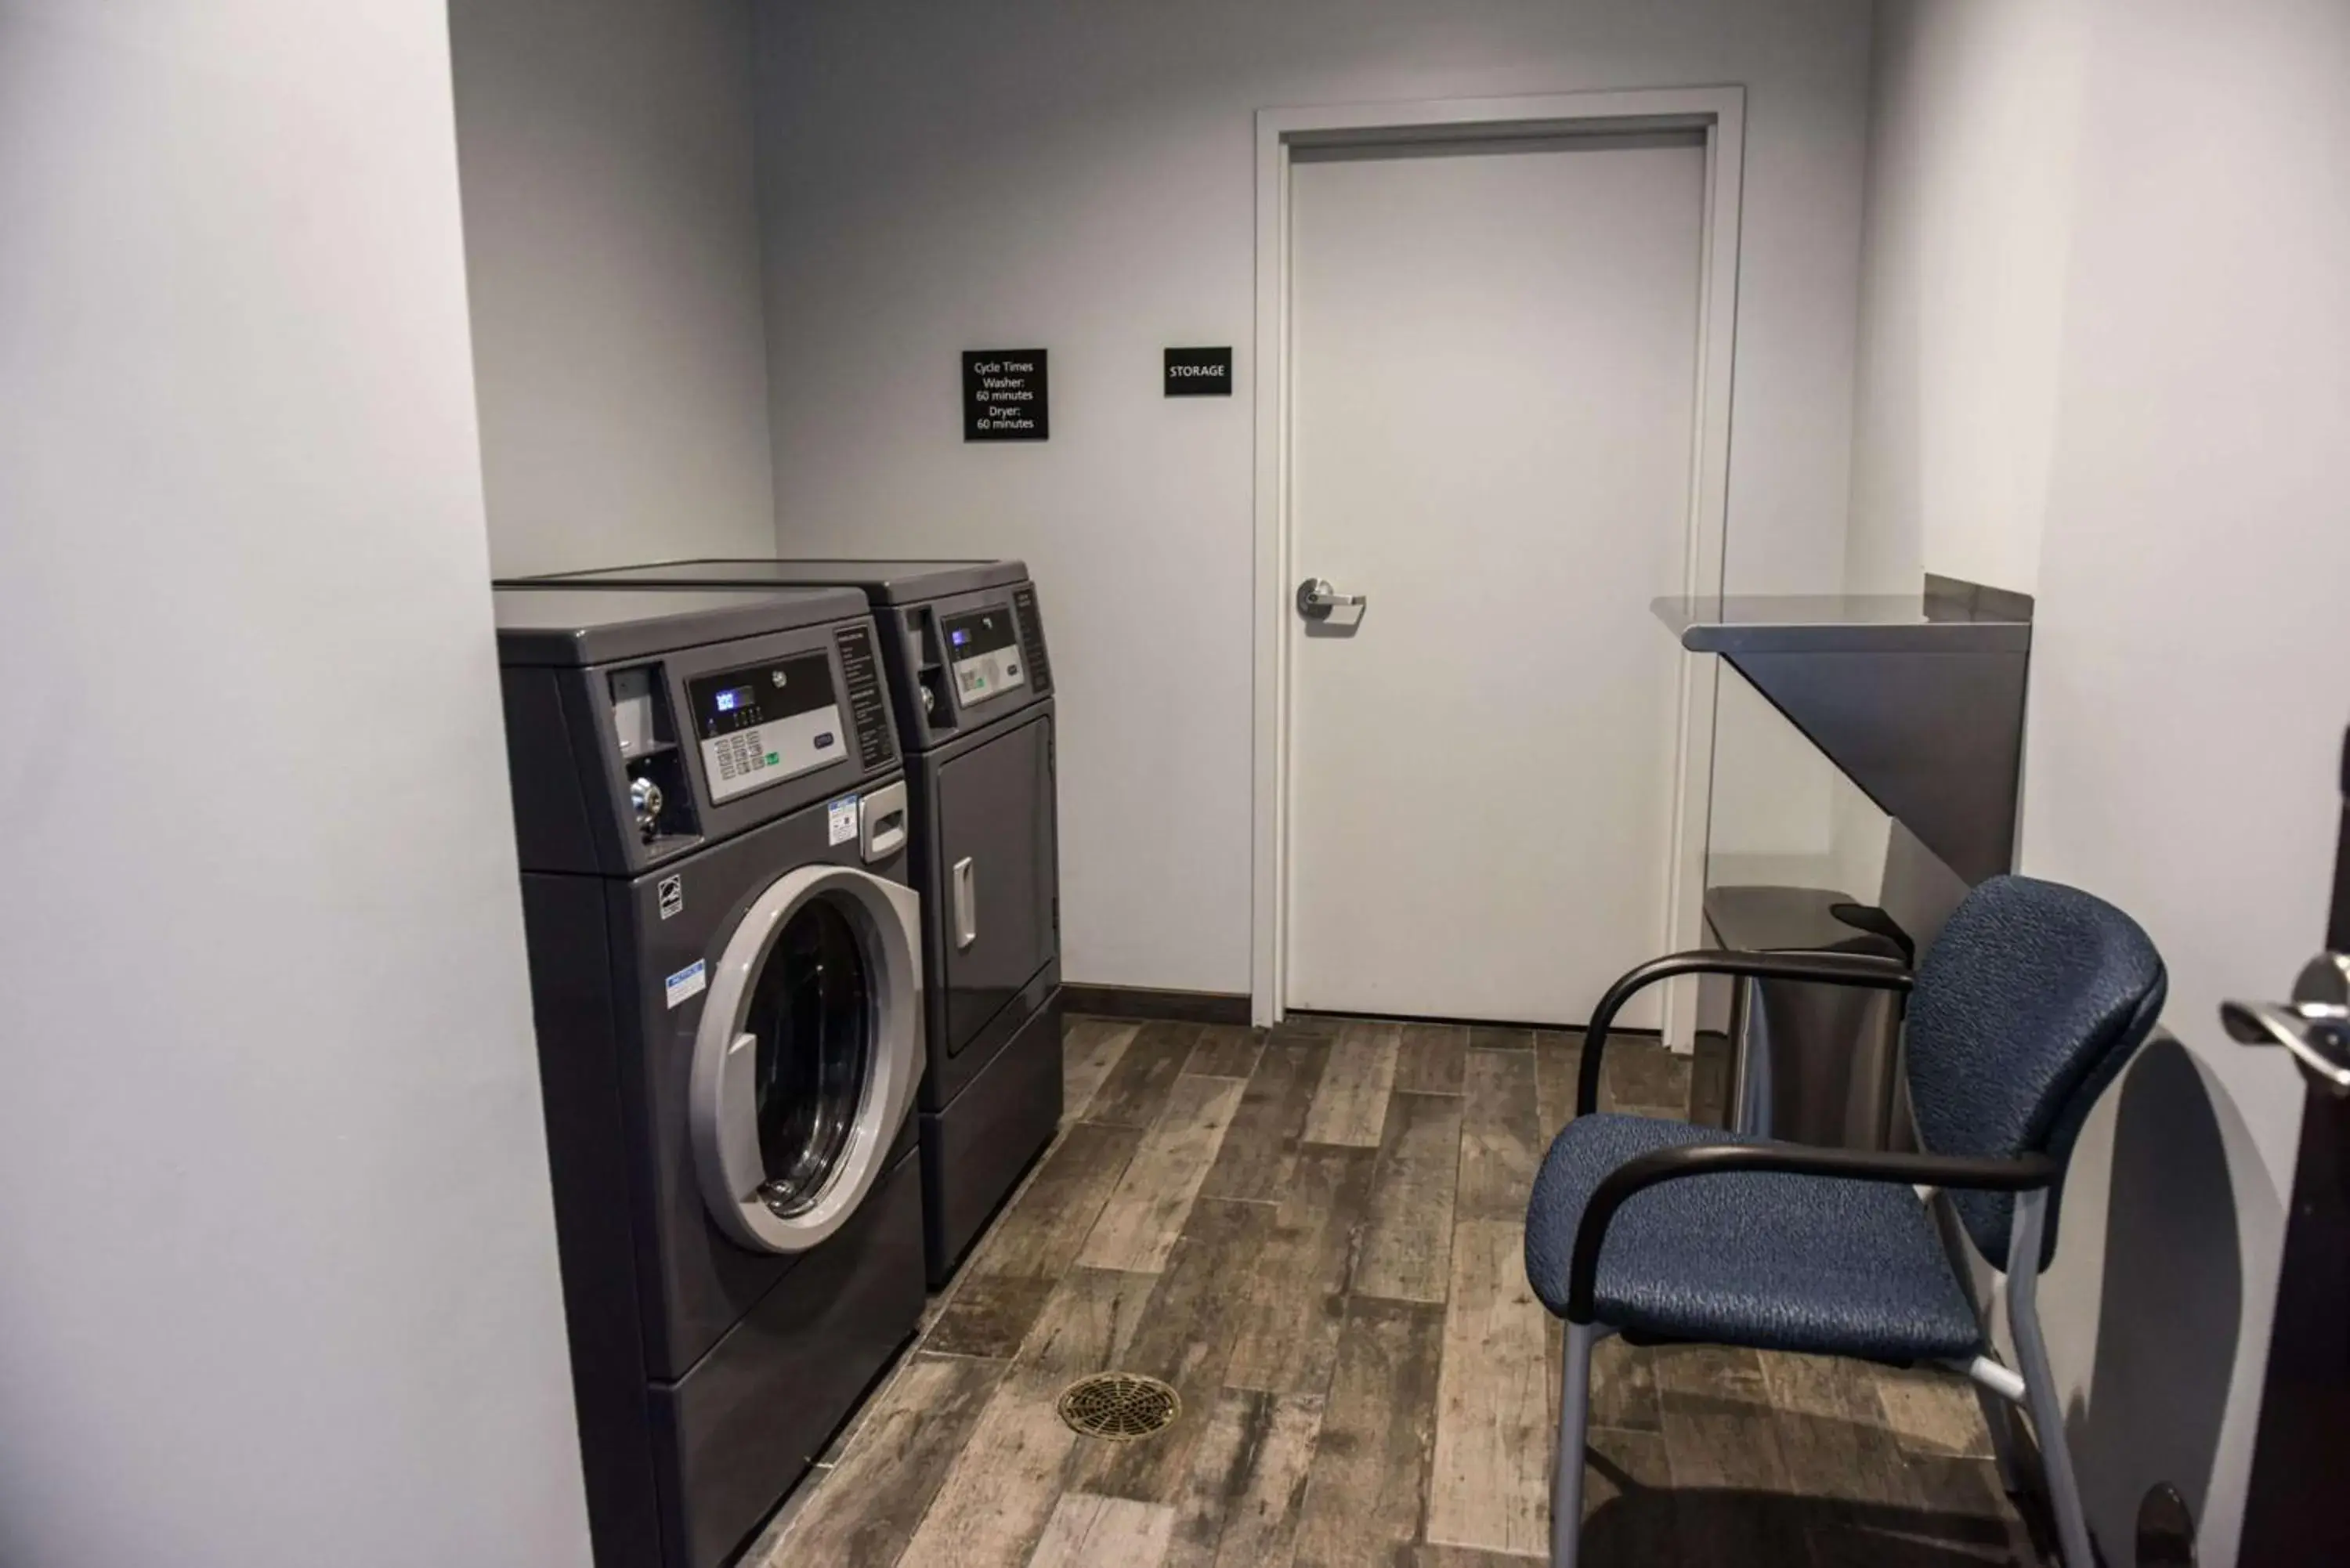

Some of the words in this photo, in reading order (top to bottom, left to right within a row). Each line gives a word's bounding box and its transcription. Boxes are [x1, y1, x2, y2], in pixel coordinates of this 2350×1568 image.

[974, 361, 1000, 375] Cycle
[1003, 361, 1034, 372] Times
[1169, 365, 1225, 378] STORAGE
[982, 378, 1025, 388] Washer:
[976, 391, 989, 401] 60
[992, 390, 1033, 401] minutes
[989, 406, 1021, 419] Dryer:
[977, 419, 990, 429] 60
[992, 417, 1034, 429] minutes
